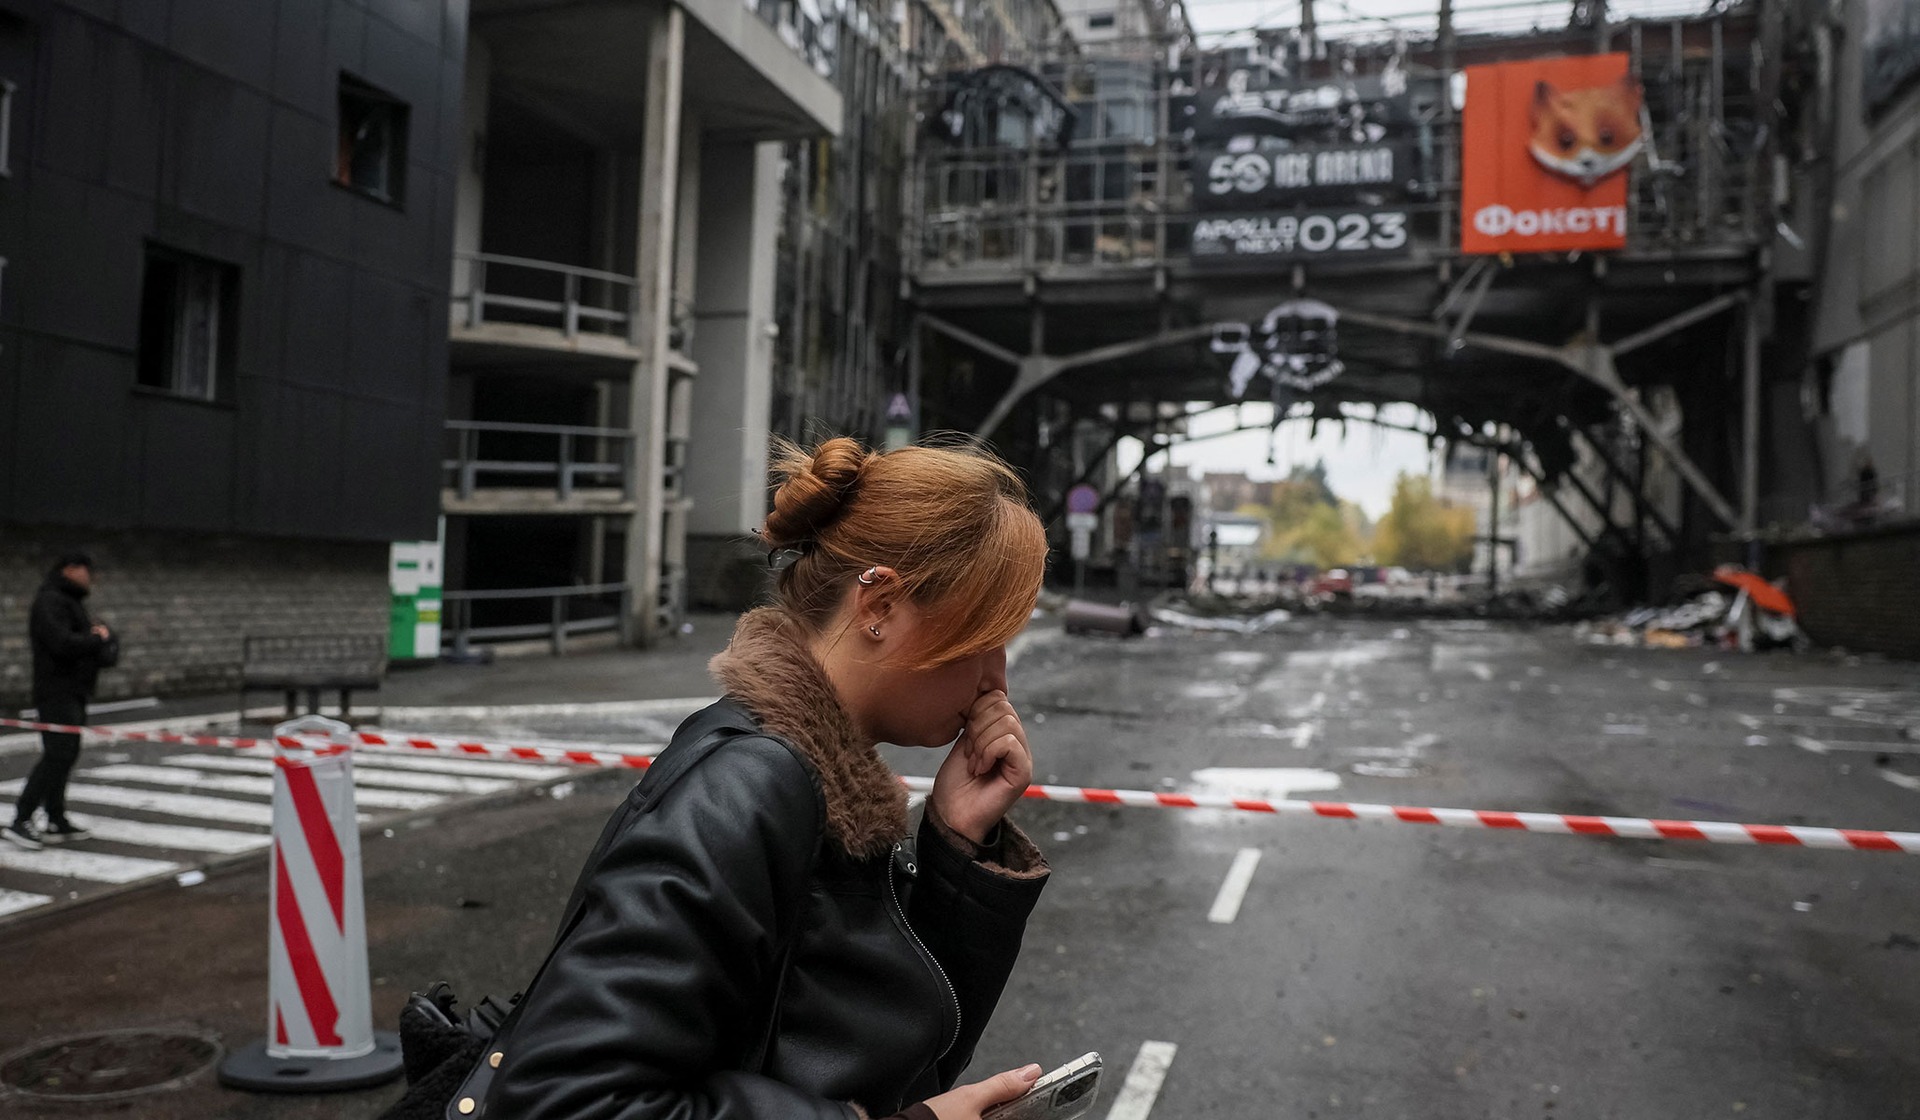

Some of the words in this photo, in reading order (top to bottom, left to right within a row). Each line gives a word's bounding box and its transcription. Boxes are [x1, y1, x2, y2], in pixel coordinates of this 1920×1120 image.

[1274, 153, 1311, 188] ICE
[1194, 216, 1299, 241] APOLLO
[1299, 212, 1407, 252] 023
[1235, 237, 1295, 255] NEXT
